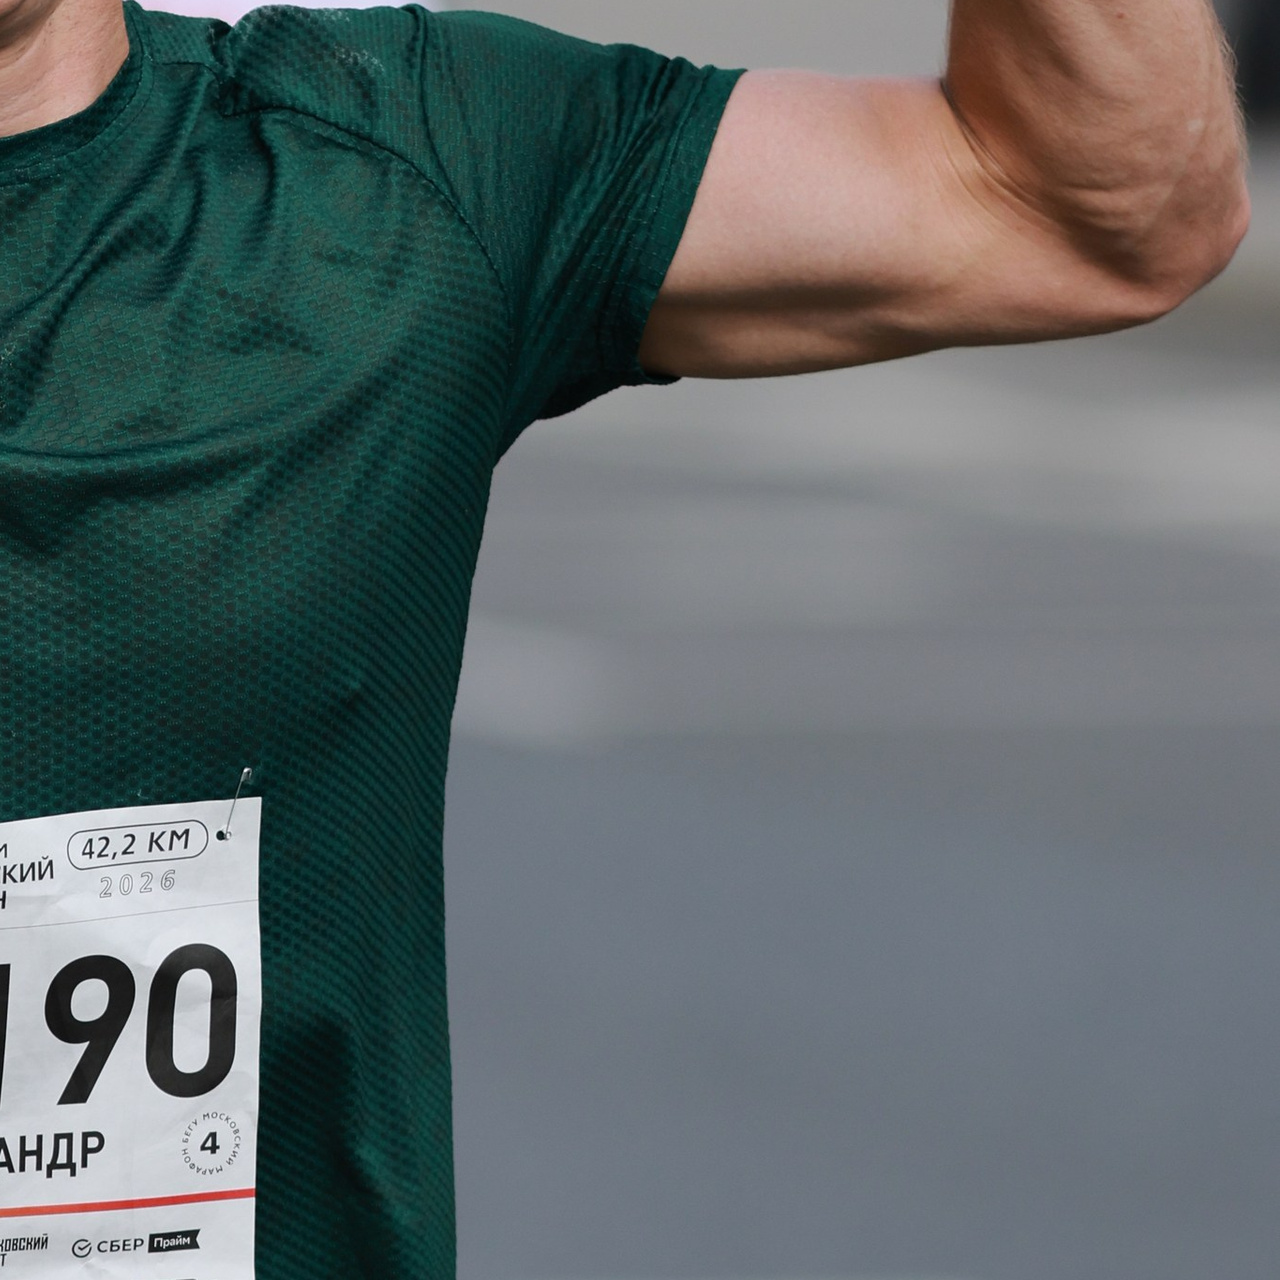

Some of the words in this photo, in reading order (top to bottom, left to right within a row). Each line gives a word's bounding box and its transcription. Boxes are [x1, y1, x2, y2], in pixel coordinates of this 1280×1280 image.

[81, 833, 136, 860] 42,2
[148, 828, 190, 853] КМ
[99, 869, 176, 899] 2026
[200, 1131, 220, 1155] 4
[97, 1238, 144, 1253] СБЕР
[154, 1235, 191, 1249] Прайм
